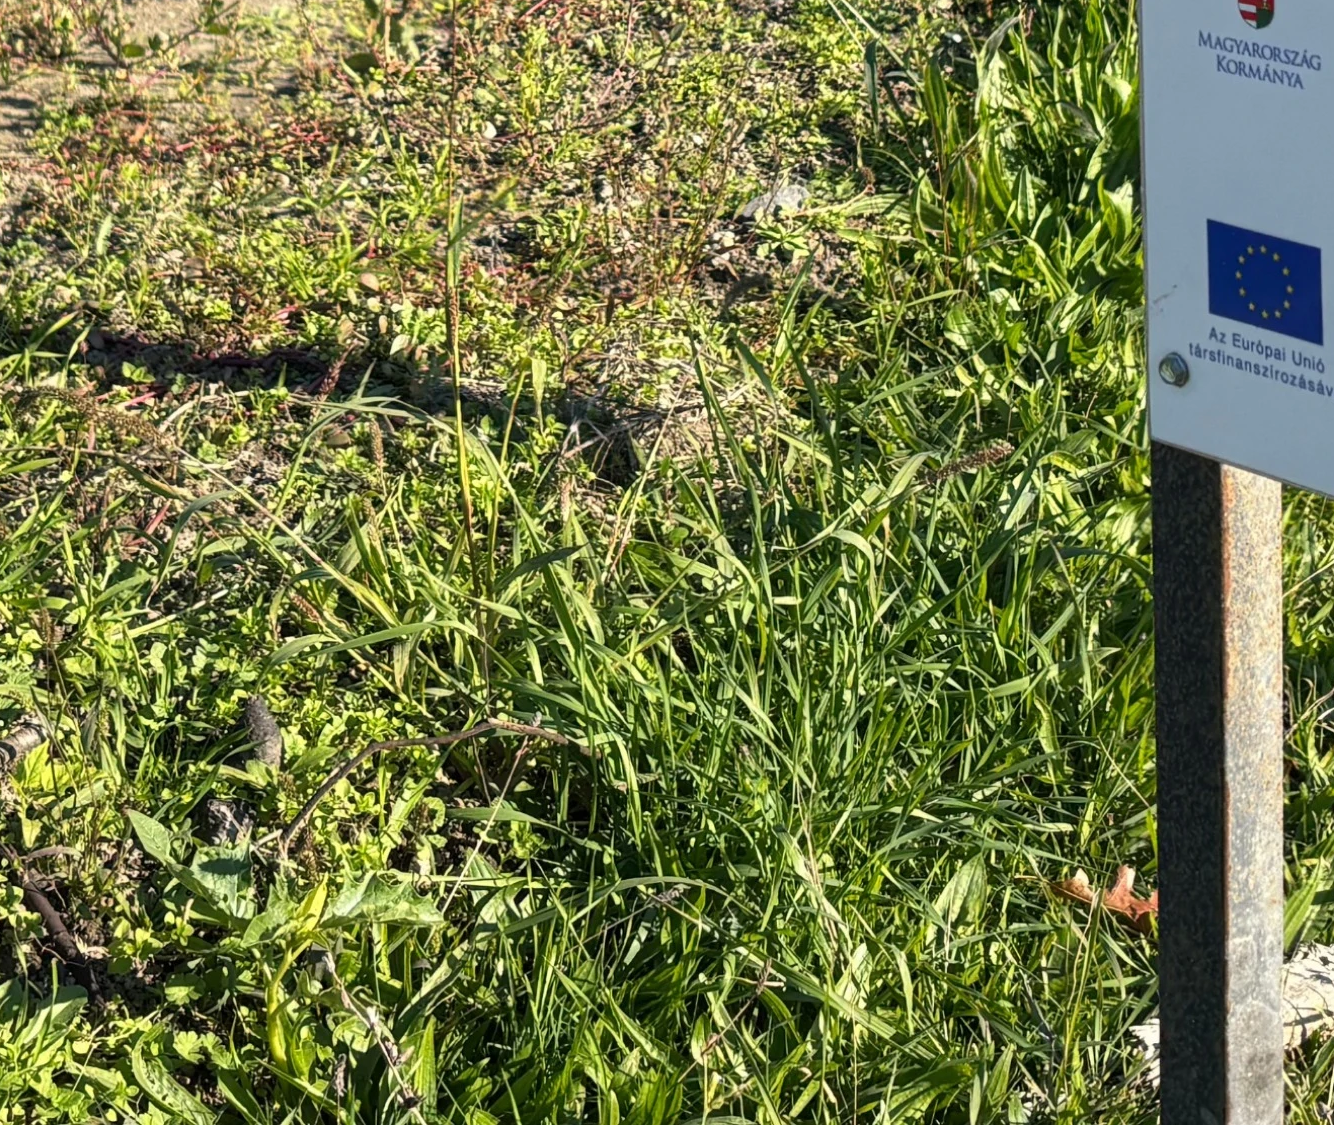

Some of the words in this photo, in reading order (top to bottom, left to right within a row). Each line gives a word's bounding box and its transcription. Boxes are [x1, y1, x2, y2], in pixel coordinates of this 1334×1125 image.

[1199, 30, 1321, 71] MAGYARORSZÁG
[1217, 54, 1304, 89] KORMÁNYA
[1209, 327, 1226, 344] Az
[1232, 333, 1286, 362] Európai
[1292, 350, 1325, 373] Unió
